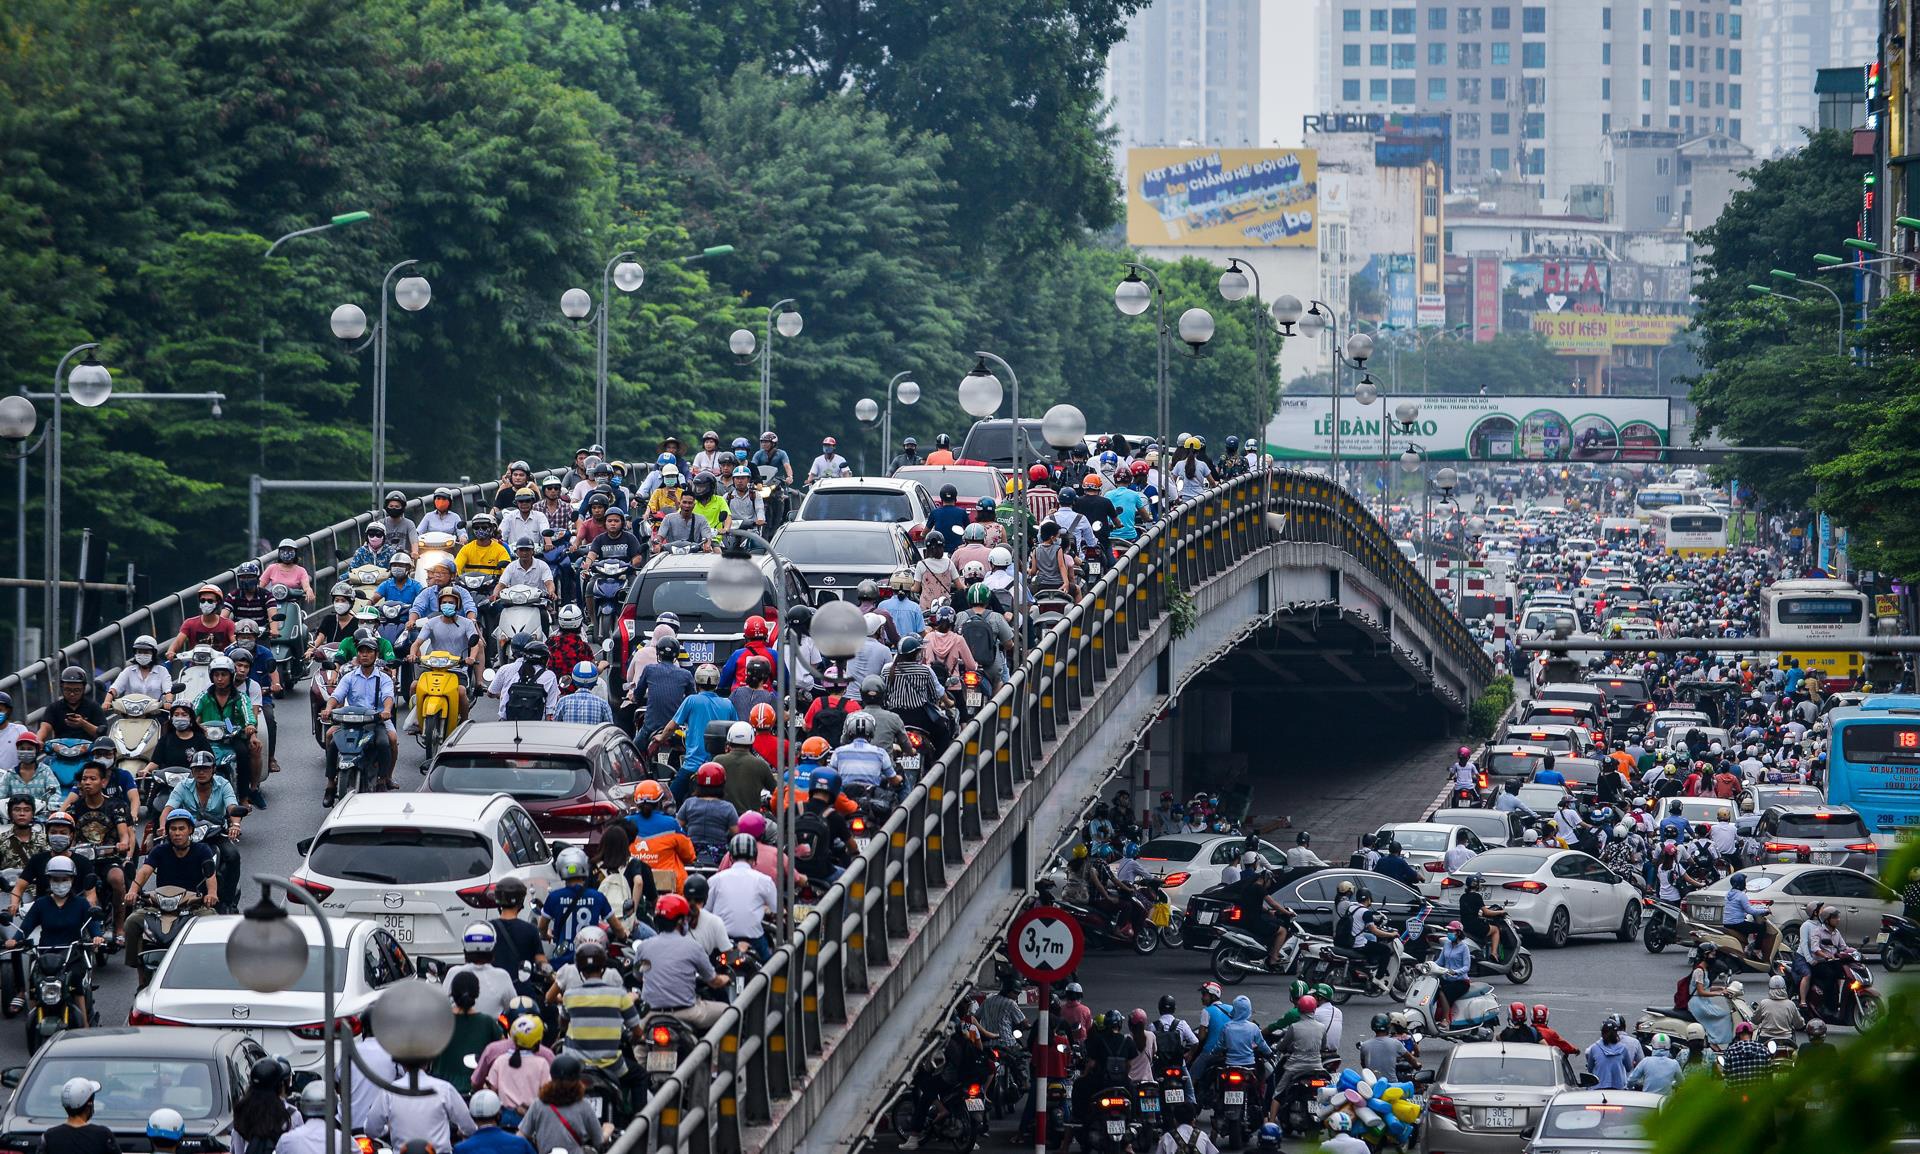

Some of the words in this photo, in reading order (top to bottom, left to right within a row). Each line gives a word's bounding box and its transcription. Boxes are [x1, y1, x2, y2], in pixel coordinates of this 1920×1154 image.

[1168, 163, 1187, 177] XE
[1165, 182, 1186, 196] be
[1283, 209, 1313, 230] be
[1339, 416, 1380, 436] BÀN
[690, 642, 707, 652] 80A
[1898, 731, 1918, 747] 18
[384, 915, 405, 928] 30E
[1025, 927, 1064, 959] 3,7m
[1492, 1109, 1507, 1117] 30E
